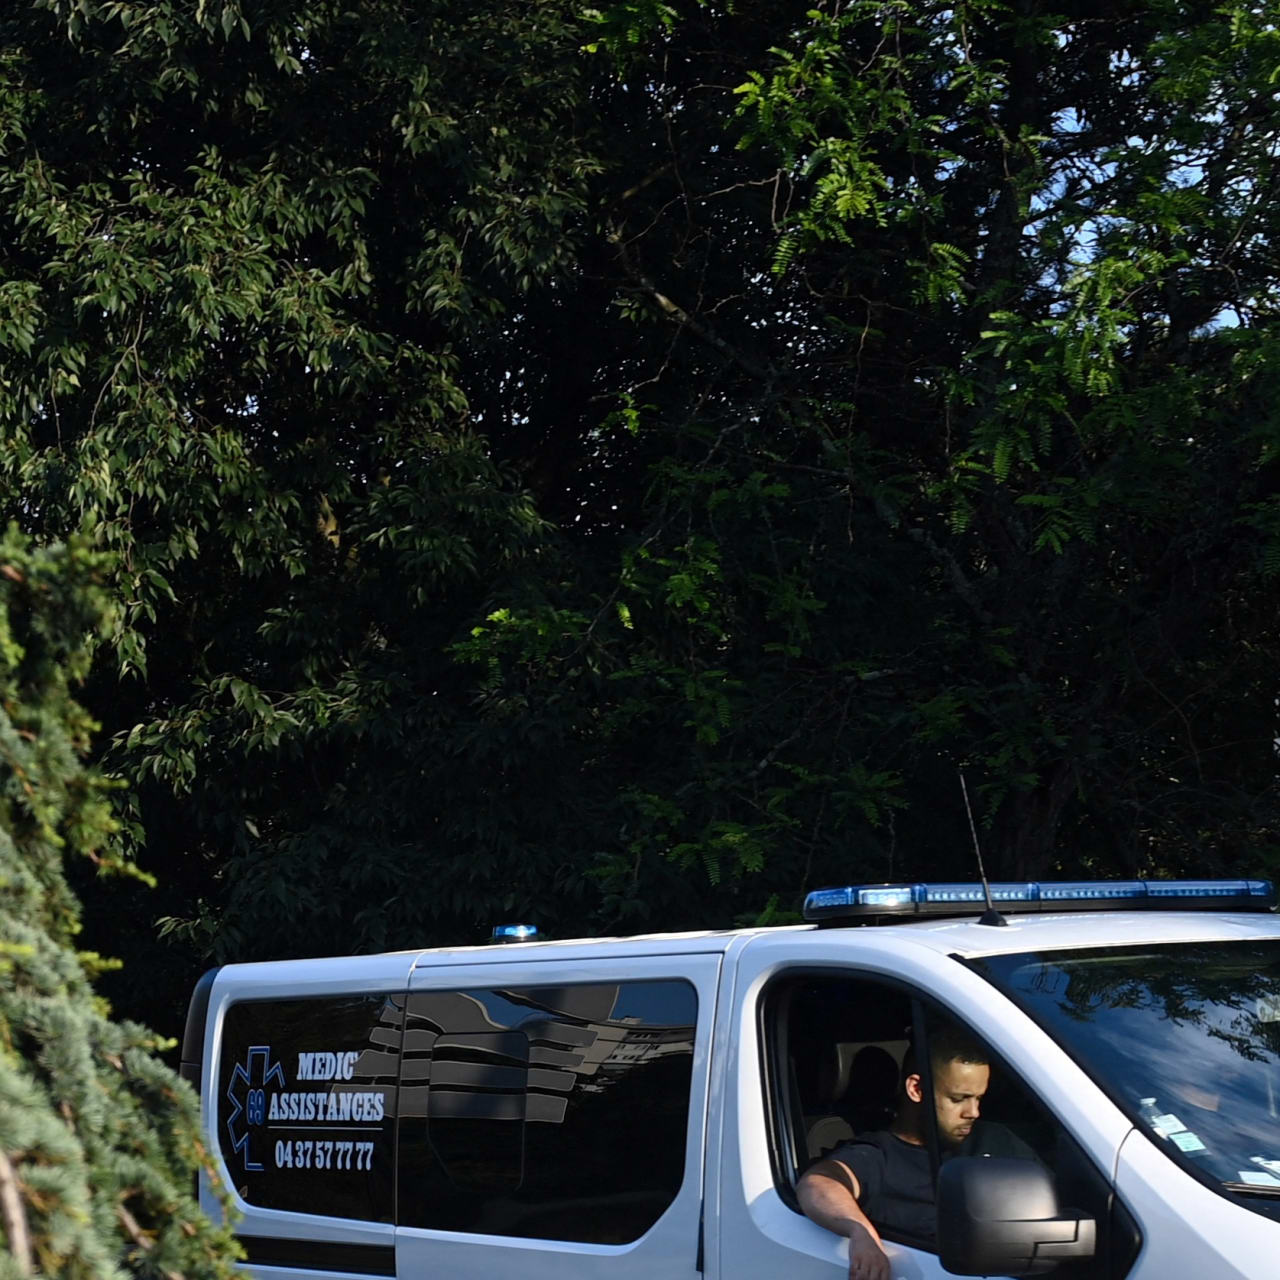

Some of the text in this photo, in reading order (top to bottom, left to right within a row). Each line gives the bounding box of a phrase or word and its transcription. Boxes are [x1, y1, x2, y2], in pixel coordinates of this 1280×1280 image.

[246, 1088, 266, 1125] 69
[268, 1092, 384, 1121] ASSISTANCES
[275, 1139, 374, 1171] 04 37 57 77 77
